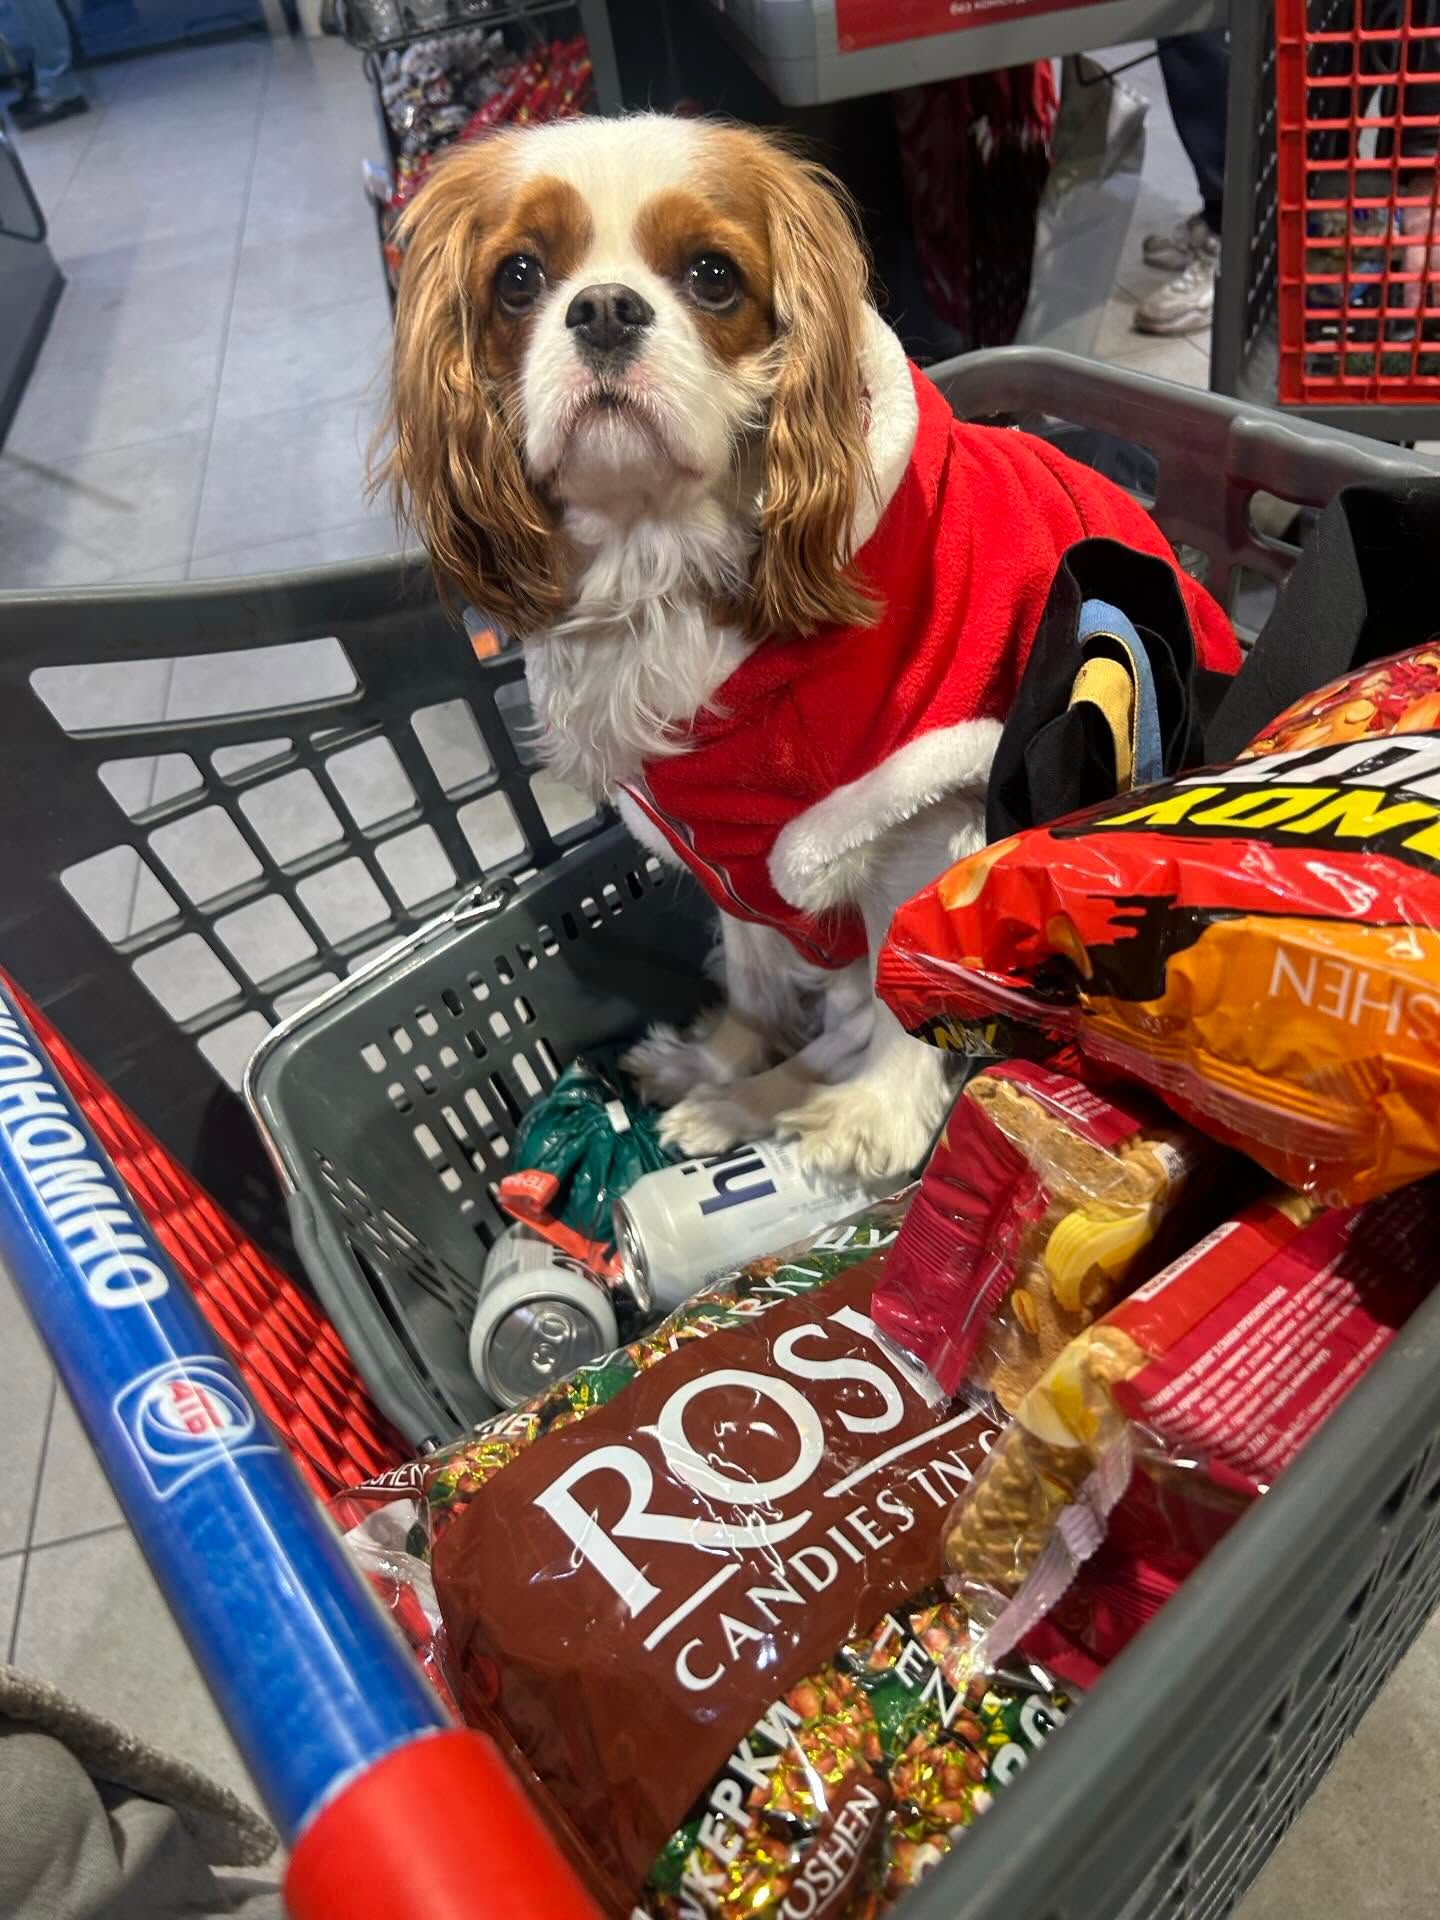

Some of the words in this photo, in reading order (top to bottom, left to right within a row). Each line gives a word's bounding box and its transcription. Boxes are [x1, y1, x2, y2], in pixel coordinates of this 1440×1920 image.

[1174, 734, 1440, 800] UT
[1094, 786, 1440, 862] NDY
[0, 996, 170, 1308] ОНОМНО
[360, 1463, 431, 1490] HEN
[676, 1488, 915, 1691] CANDIES
[776, 1784, 880, 1920] OSHEN
